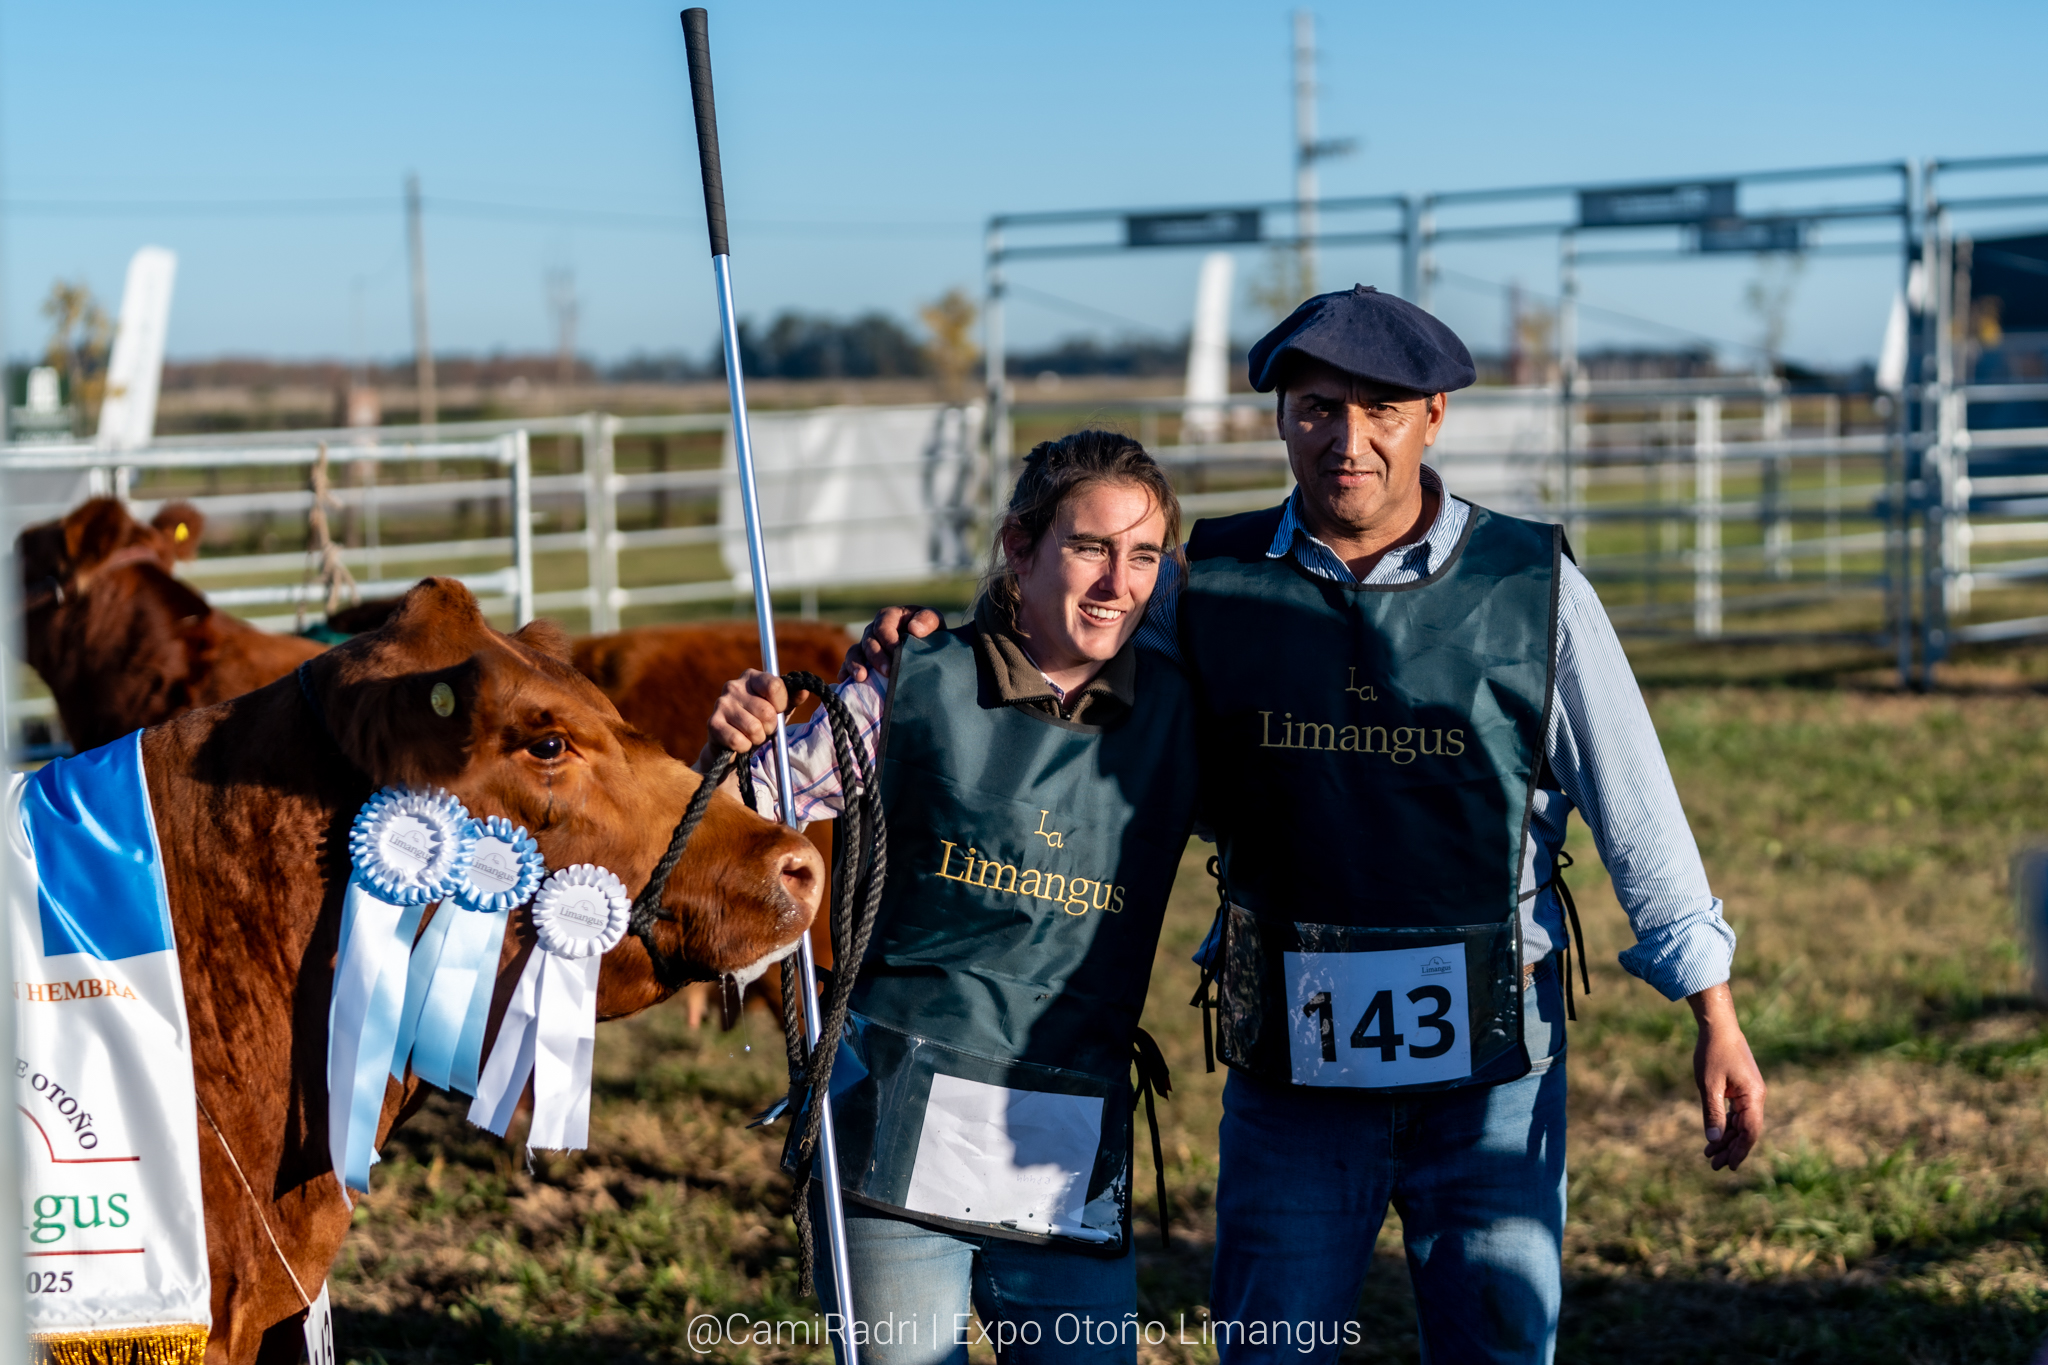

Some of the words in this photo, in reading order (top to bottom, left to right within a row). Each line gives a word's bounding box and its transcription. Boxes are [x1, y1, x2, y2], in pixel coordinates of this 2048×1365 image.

[1345, 667, 1378, 701] La
[1258, 711, 1465, 764] Limangus
[1034, 809, 1064, 848] La
[471, 857, 514, 882] Limangus
[935, 839, 1126, 917] Limangus
[560, 906, 604, 926] Limangus
[1421, 965, 1452, 974] Limangus
[26, 978, 138, 1002] HEMBRA
[1302, 984, 1455, 1063] 143
[31, 1073, 98, 1150] OTOÑO
